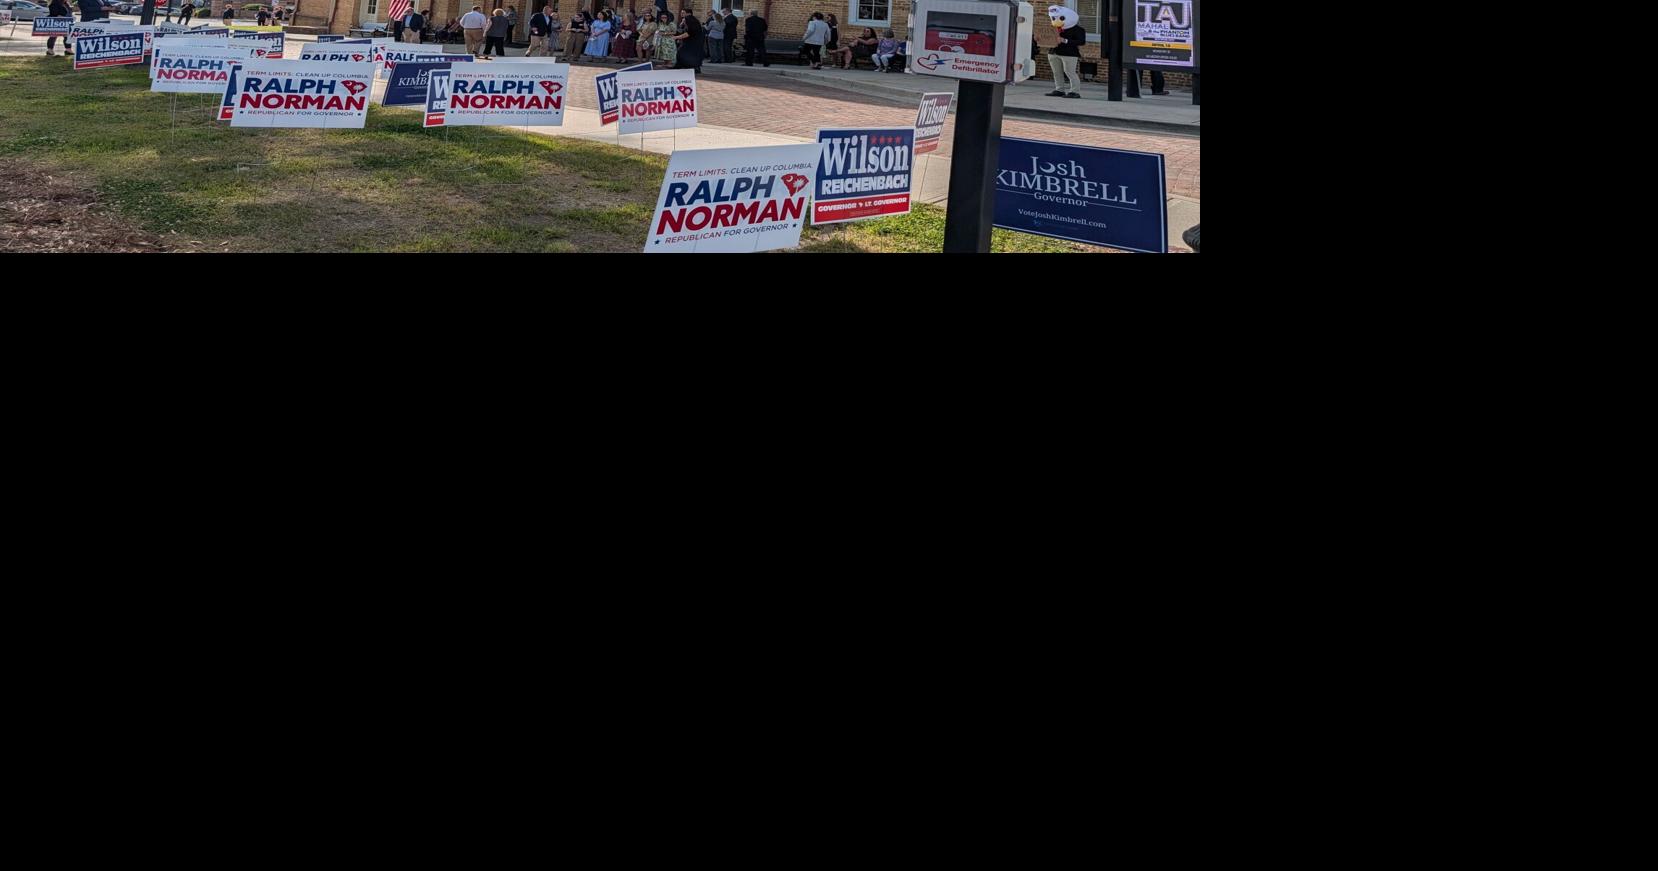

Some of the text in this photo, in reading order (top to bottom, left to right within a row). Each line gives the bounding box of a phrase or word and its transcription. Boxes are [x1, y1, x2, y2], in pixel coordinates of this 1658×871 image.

[1138, 1, 1190, 28] TAJ
[79, 37, 141, 53] Wilson
[160, 58, 223, 70] RALPH
[386, 53, 415, 62] RALP
[954, 58, 1000, 68] Emergency
[157, 69, 228, 81] NORMA
[952, 64, 999, 75] Defibrillator
[244, 77, 336, 94] RALPH
[453, 80, 534, 94] RALPH
[240, 93, 366, 110] NORMAN
[450, 94, 562, 109] NORMAN
[622, 86, 674, 103] RALPH
[622, 99, 694, 118] NORMAN
[918, 98, 948, 126] Wilson
[822, 134, 908, 176] Wilson
[672, 170, 697, 178] TERM
[699, 168, 728, 176] LIMITS.
[730, 166, 758, 174] CLEAN
[1030, 156, 1086, 178] Josh
[664, 175, 776, 207] RALPH
[821, 174, 908, 195] REICHENBACH
[996, 168, 1137, 205] KIMBRELL
[818, 202, 857, 212] GOVERNOR
[874, 197, 907, 206] GOVERNOR
[1034, 192, 1088, 207] Governor
[656, 197, 806, 235] NORMAN
[1018, 208, 1107, 229] VoteJoshKimbrell.com
[665, 223, 789, 244] REPUBLICAN FOR GOVERNOR
